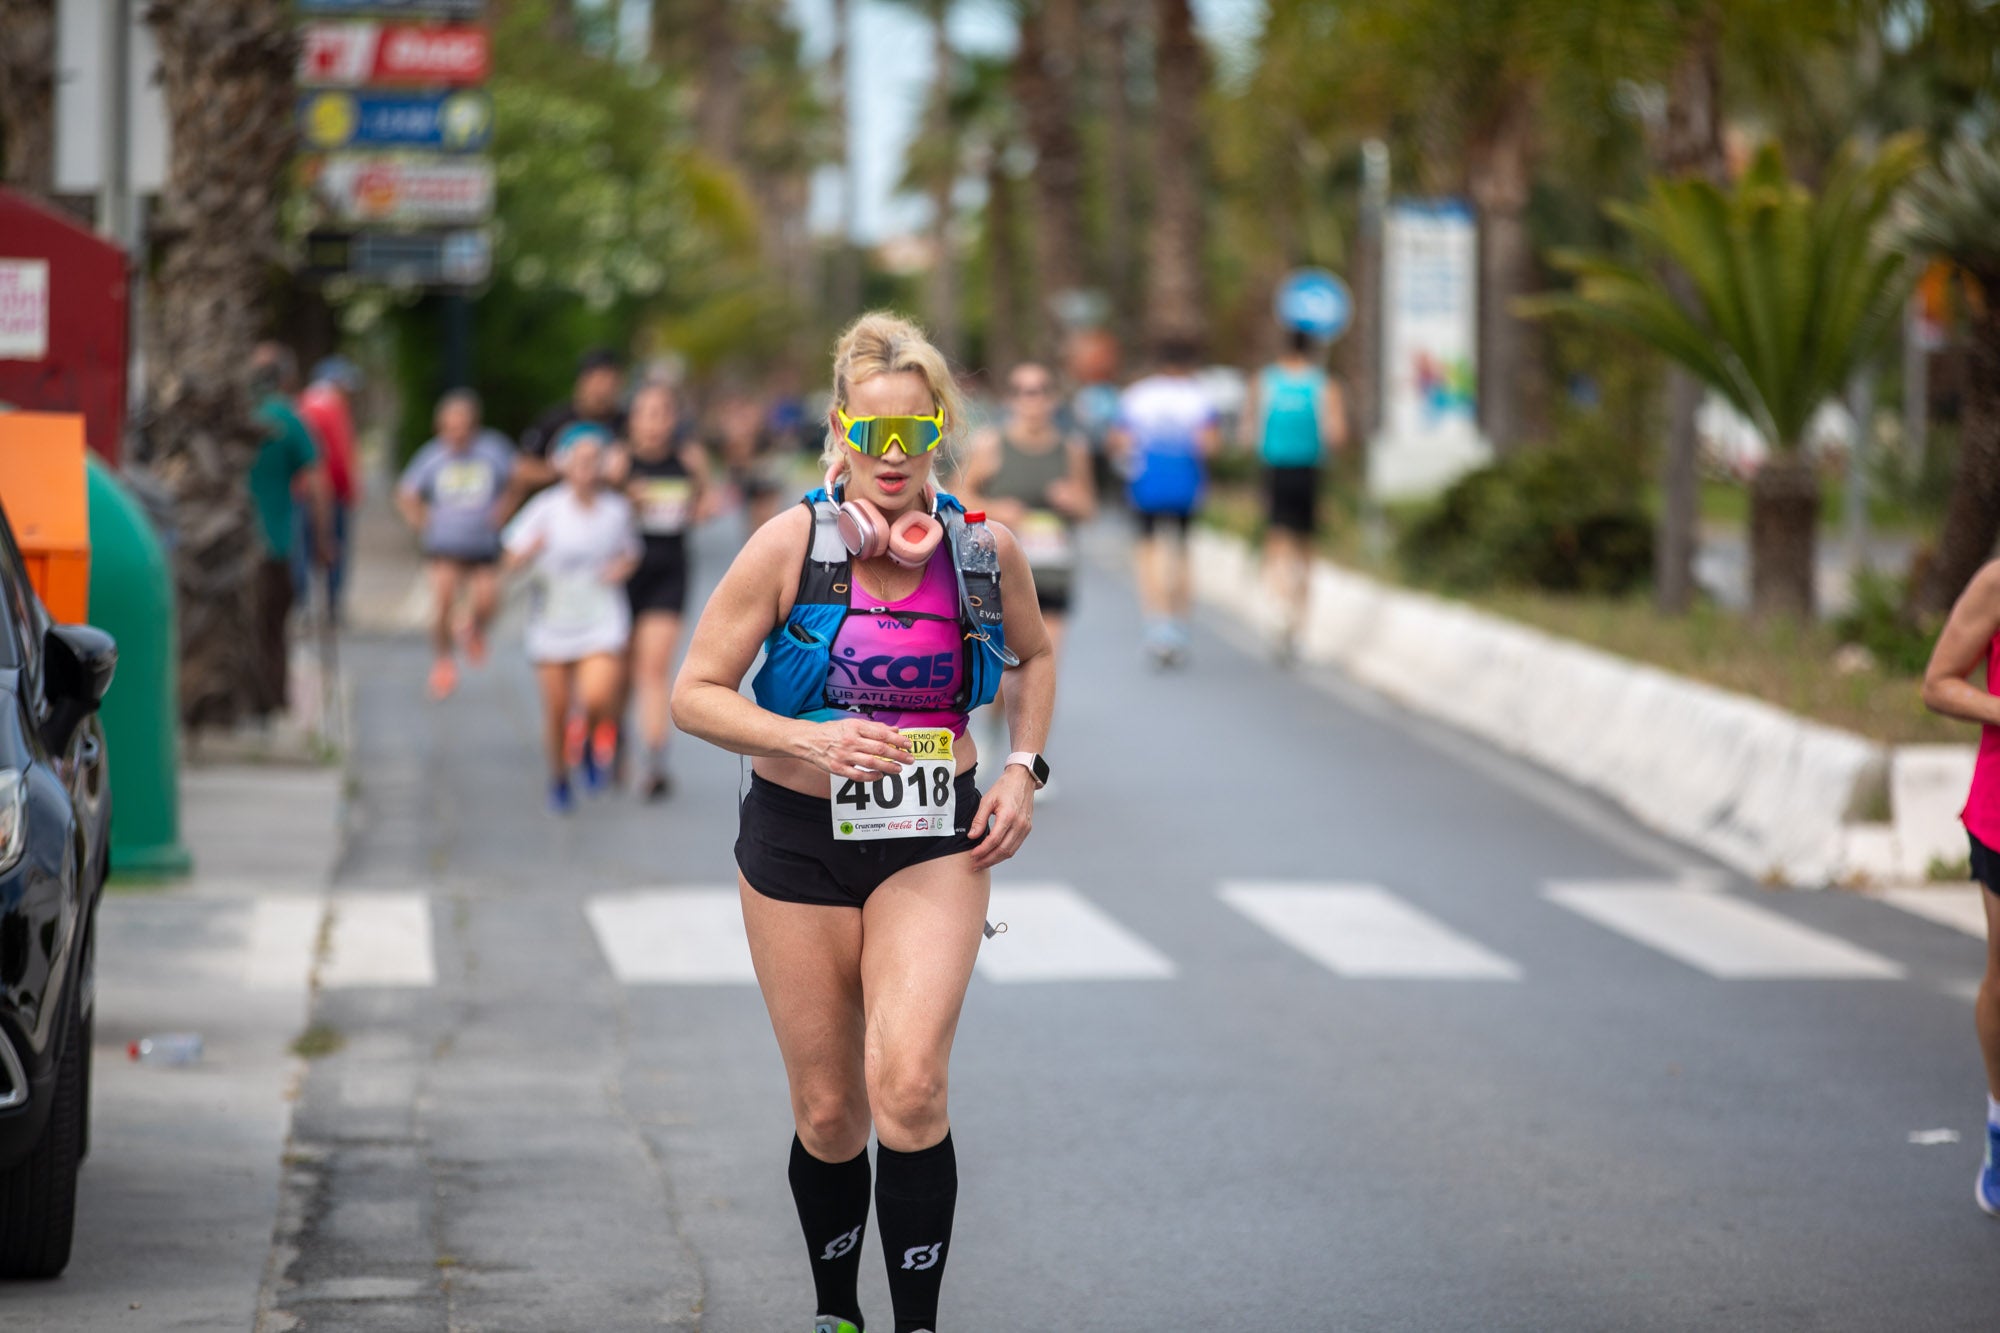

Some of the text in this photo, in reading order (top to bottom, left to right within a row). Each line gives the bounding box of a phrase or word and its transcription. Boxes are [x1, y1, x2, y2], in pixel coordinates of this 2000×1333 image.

[979, 609, 1003, 620] EVAD
[858, 652, 954, 689] cas
[836, 766, 950, 811] 4018
